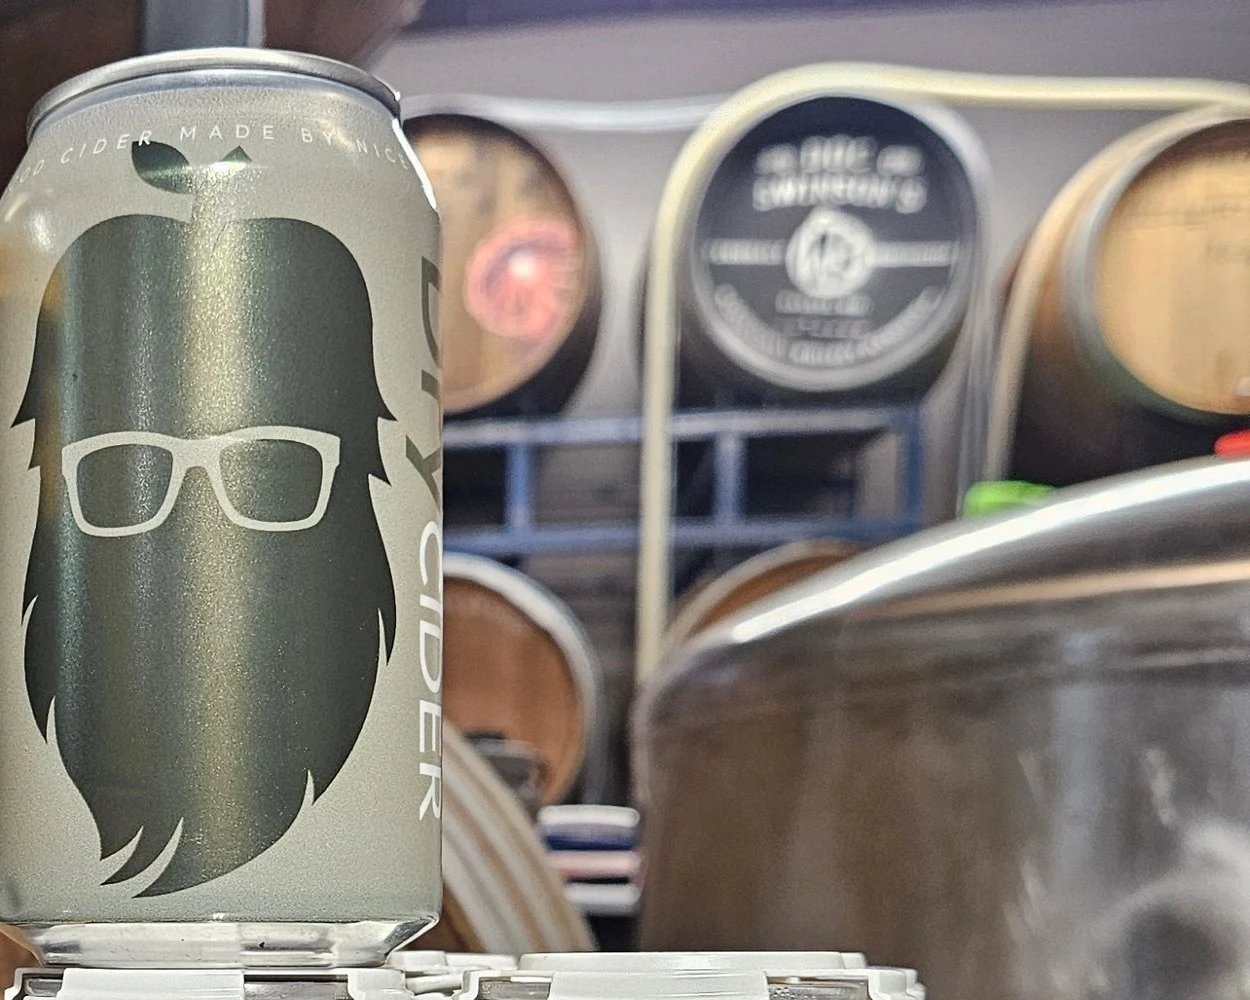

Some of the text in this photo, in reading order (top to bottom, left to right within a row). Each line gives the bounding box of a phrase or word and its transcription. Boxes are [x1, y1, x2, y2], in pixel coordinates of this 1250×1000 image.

[60, 131, 152, 164] CIDER
[180, 125, 274, 141] MADE
[301, 128, 332, 143] BY
[356, 139, 408, 170] NICE
[419, 520, 443, 820] CIDER
